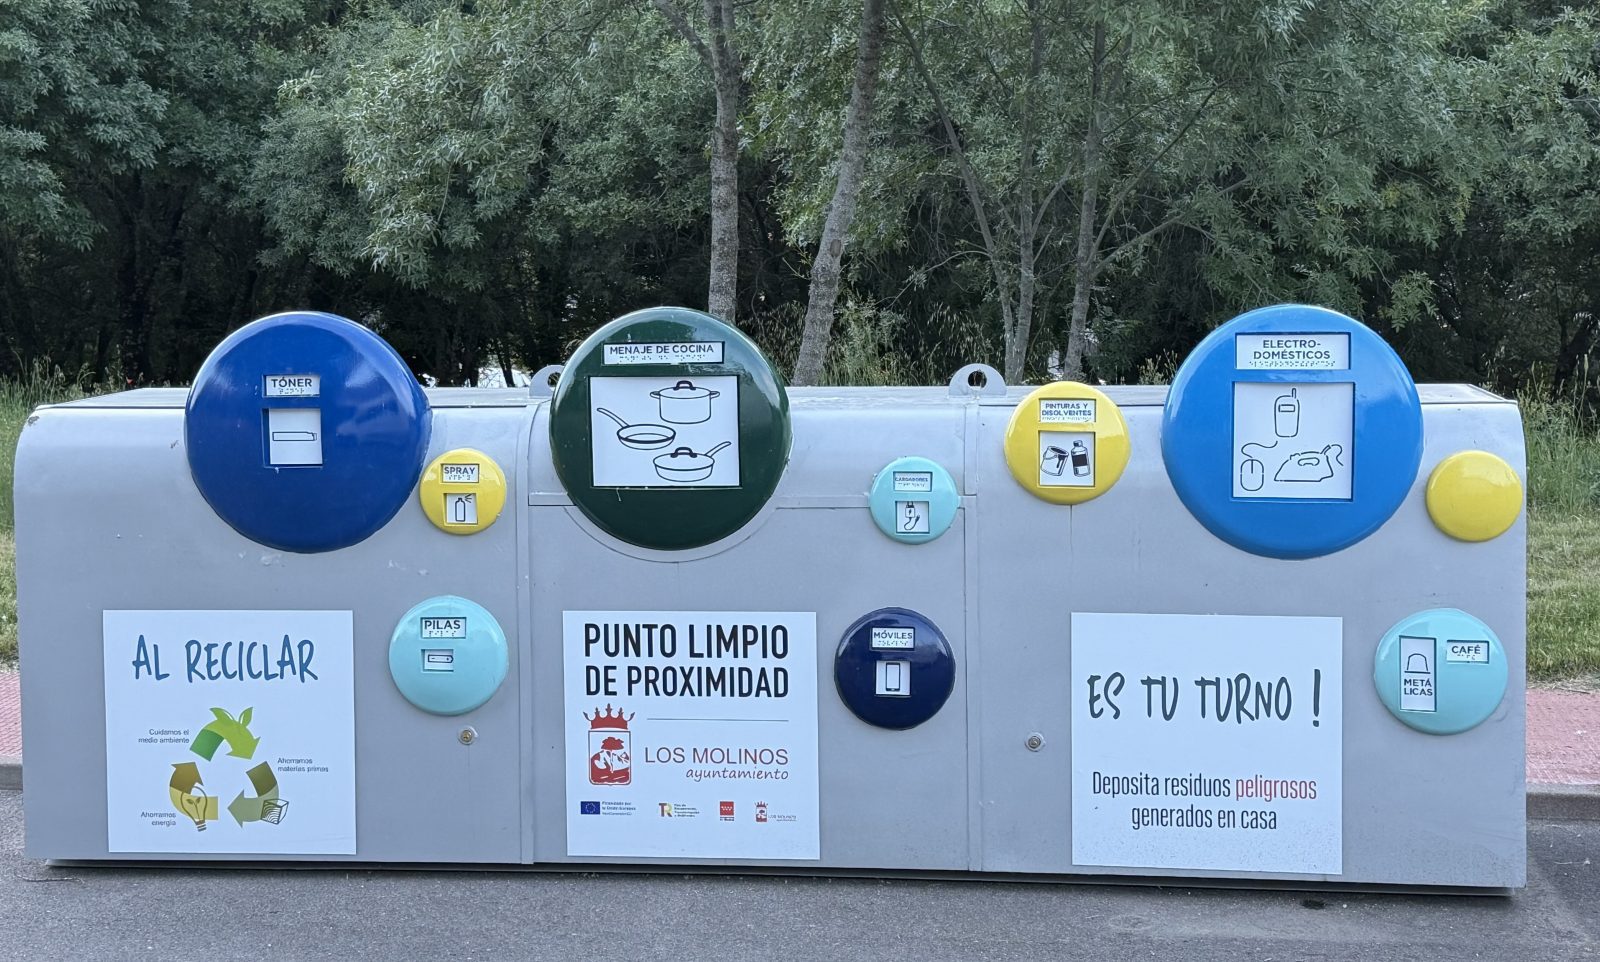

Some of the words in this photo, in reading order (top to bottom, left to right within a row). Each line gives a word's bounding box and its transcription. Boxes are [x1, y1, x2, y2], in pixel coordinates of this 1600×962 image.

[609, 345, 653, 355] MENAJE
[656, 345, 670, 354] DE
[672, 344, 714, 353] COCINA
[1262, 339, 1321, 349] ELECTRO-
[1253, 349, 1331, 360] DOMÉSTICOS
[271, 376, 313, 388] TÓNER
[443, 466, 475, 475] SPRAY
[424, 620, 461, 630] PILAS
[873, 630, 913, 639] MÓVILES
[584, 623, 677, 658] PUNTO
[688, 624, 789, 659] LIMPIO
[1451, 644, 1481, 655] CAFÉ
[132, 634, 170, 681] AL
[185, 634, 318, 683] RECICLAR
[585, 665, 617, 696] DE
[627, 665, 789, 698] PROXIMIDAD
[1403, 678, 1432, 687] METÁ
[1403, 687, 1433, 696] LICAS
[1087, 671, 1125, 720] ES
[1140, 675, 1179, 722] TU
[1194, 672, 1292, 724] TURNO
[1312, 668, 1321, 727] !
[644, 747, 685, 764] LOS
[692, 747, 789, 765] MOLINOS
[686, 766, 789, 783] ayuntamiento
[1092, 771, 1160, 799] Deposita
[1164, 772, 1231, 798] residuos
[1235, 774, 1317, 803] peligrosos
[1131, 803, 1213, 831] generados
[1217, 809, 1236, 829] en
[1240, 810, 1277, 830] casa
